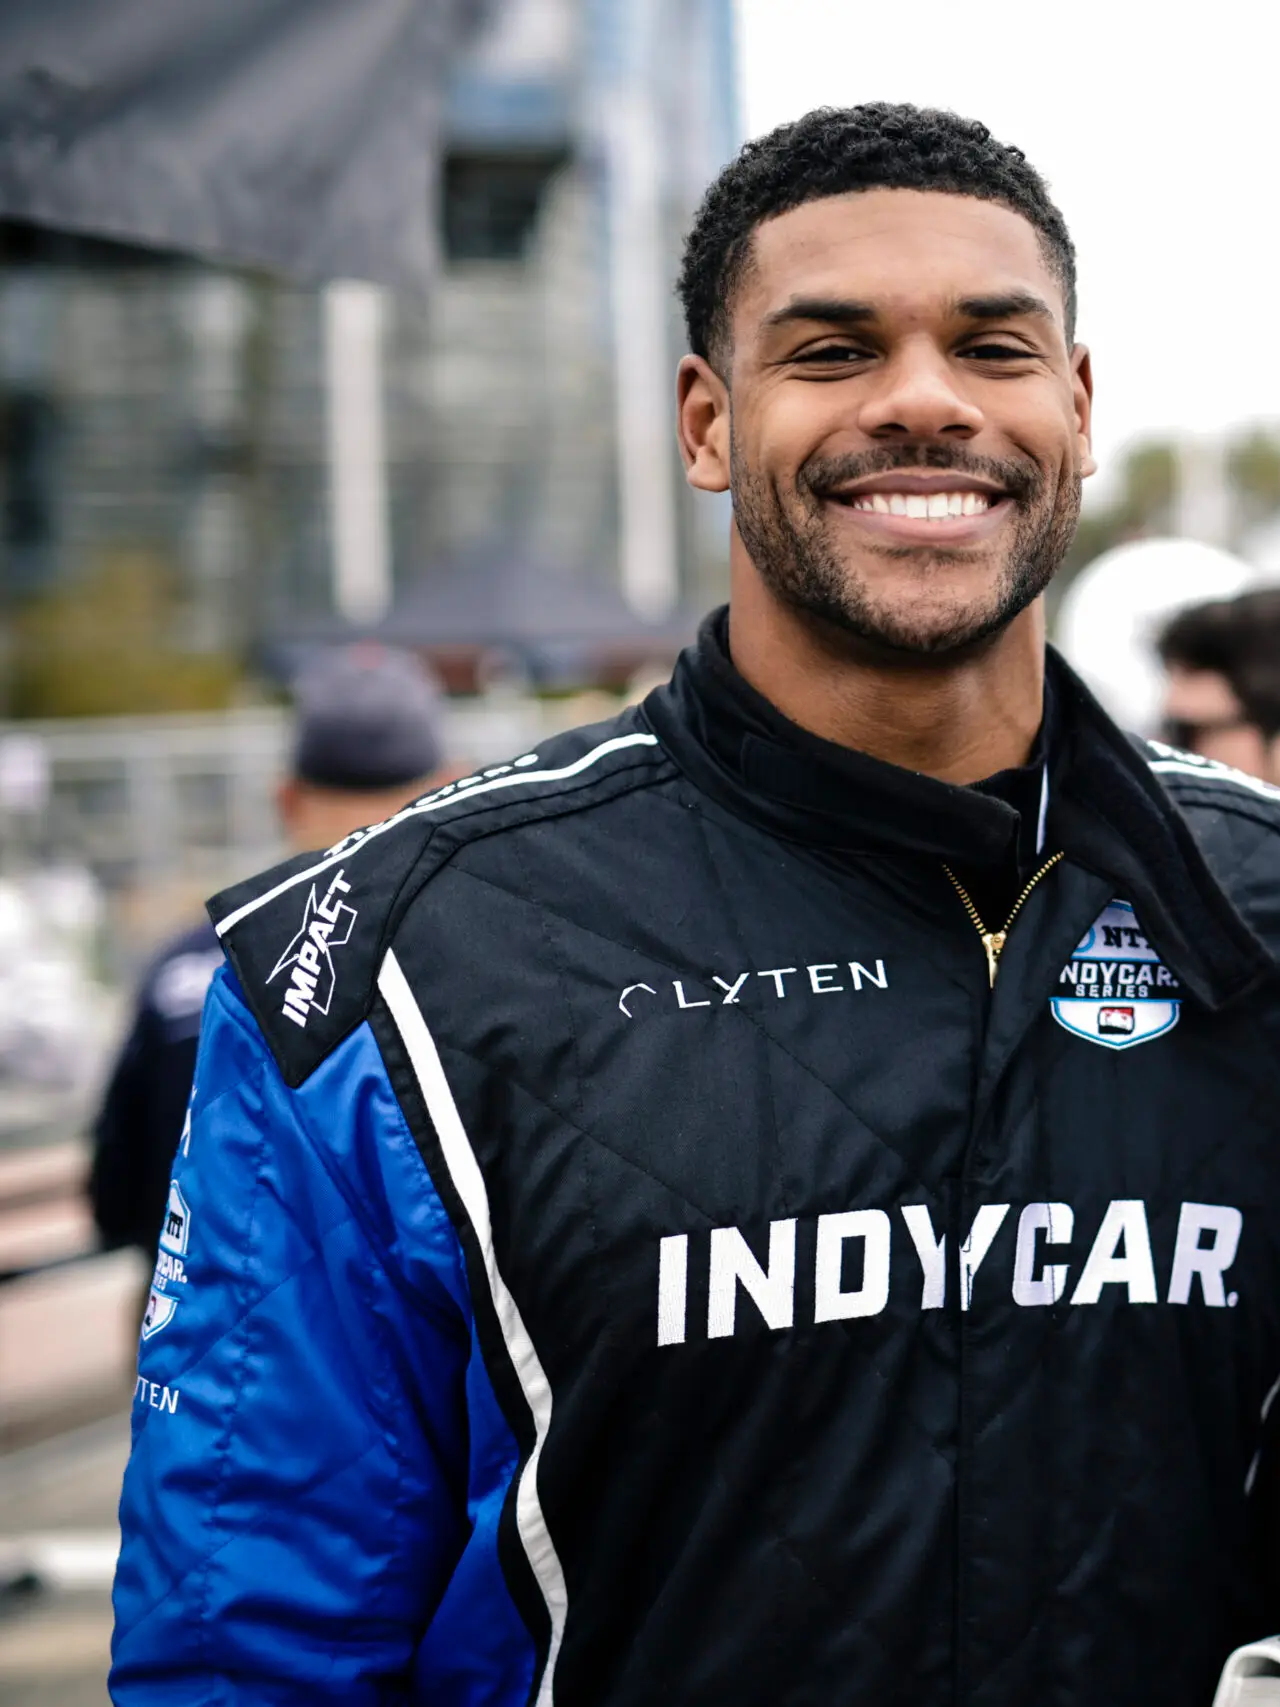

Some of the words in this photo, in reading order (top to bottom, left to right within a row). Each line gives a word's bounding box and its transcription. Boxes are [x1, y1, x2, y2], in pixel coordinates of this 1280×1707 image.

[281, 868, 351, 1028] IMPACT
[672, 959, 888, 1009] LYTEN
[1059, 961, 1179, 987] NDYCAR.
[1075, 984, 1149, 998] SERIES
[133, 1375, 179, 1414] TEN
